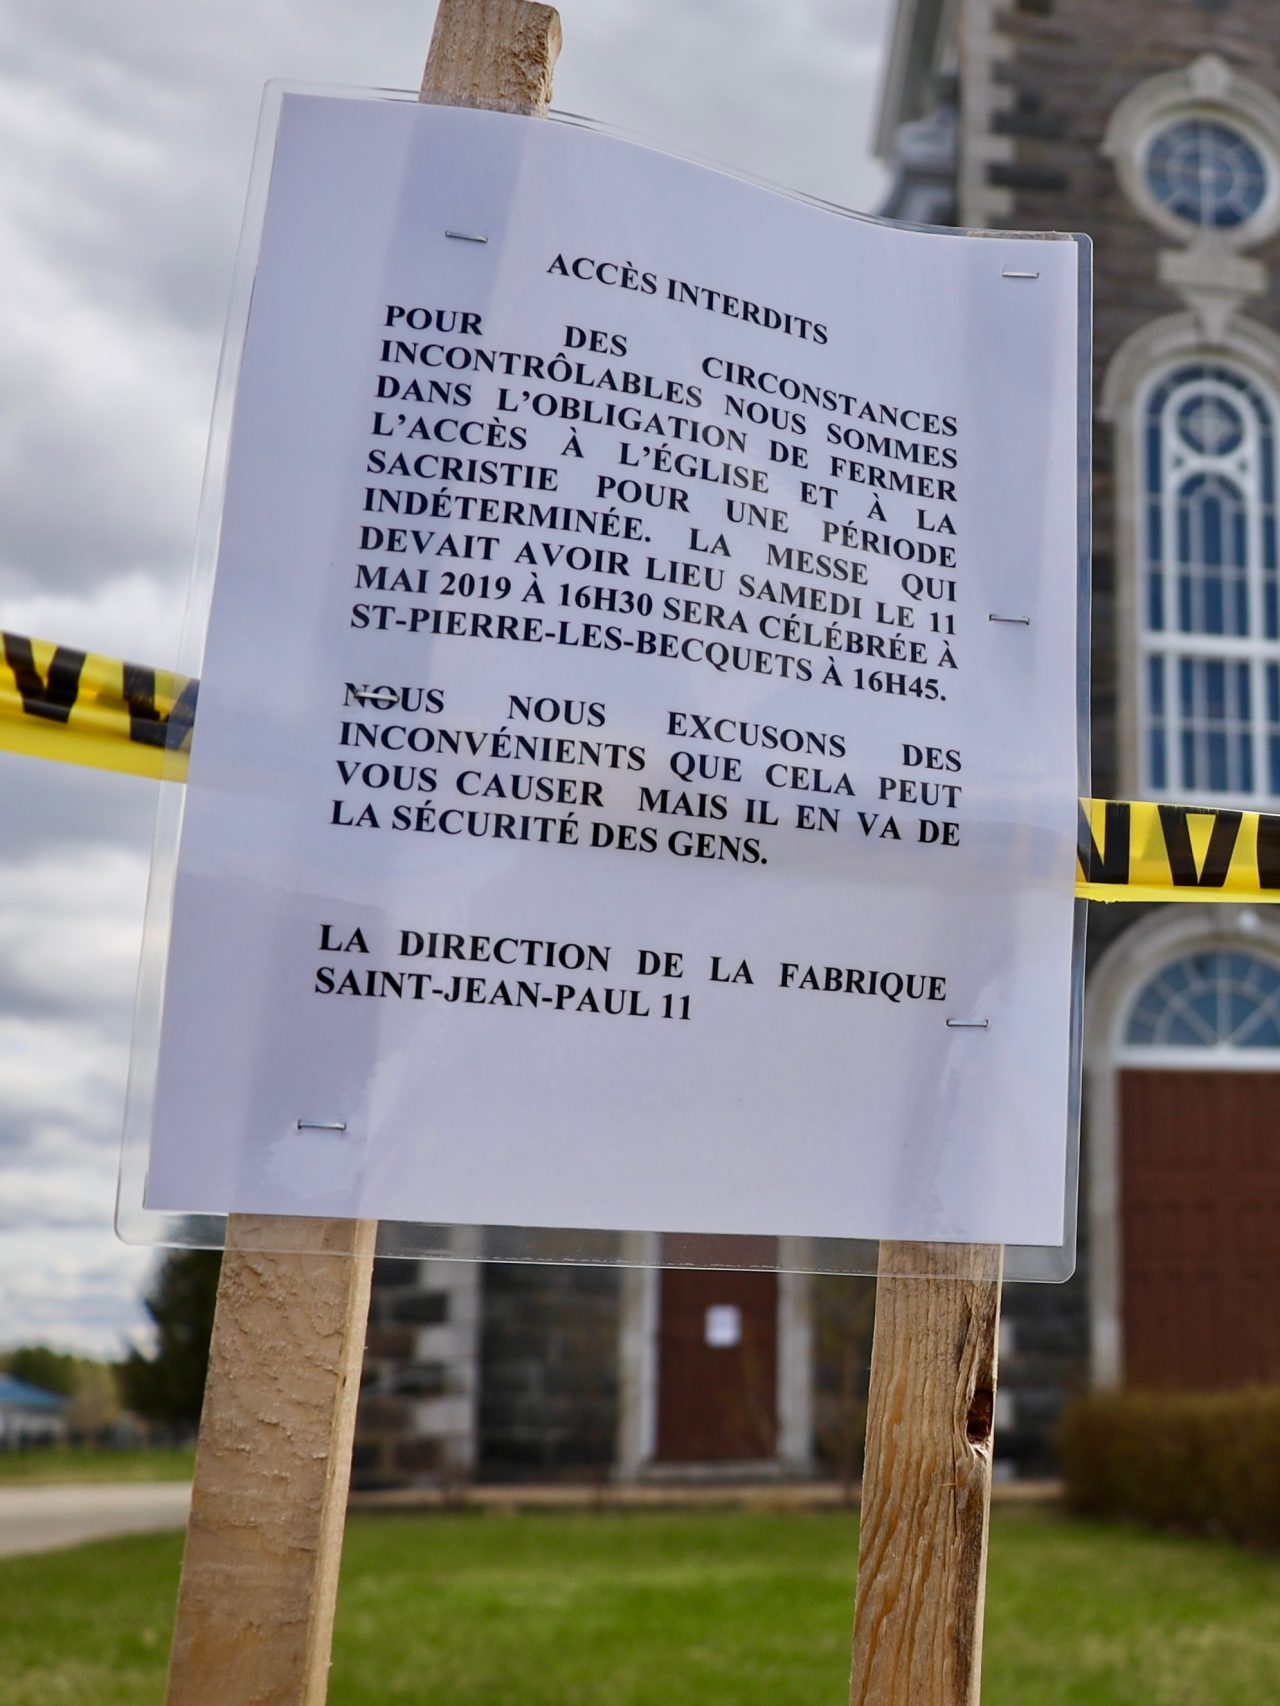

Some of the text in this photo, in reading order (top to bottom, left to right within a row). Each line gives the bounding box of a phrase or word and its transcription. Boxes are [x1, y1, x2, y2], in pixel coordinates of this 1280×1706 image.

[546, 253, 828, 345] ACCÈS INTERDITS
[380, 339, 958, 469] INCONTRÔLABLES NOUS SOMMES
[384, 304, 958, 437] POUR DES CIRCONSTANCES
[376, 374, 472, 407] DANS
[769, 439, 809, 470] DE
[829, 455, 958, 502] FERMER
[560, 426, 585, 459] À
[800, 480, 839, 510] ET
[866, 492, 888, 523] À
[917, 508, 957, 536] LA
[363, 486, 957, 603] INDÉTERMINÉE. LA MESSE QUI
[366, 449, 957, 569] SACRISTIE POUR UNE PÉRIODE
[355, 564, 959, 670] MAI 2019 À 16H30 SERA CÉLÉBRÉE À
[359, 525, 956, 636] DEVAIT AVOIR LIEU SAMEDI LE 11
[350, 603, 947, 702] ST-PIERRE-LES-BECQUETS À 16H45.
[339, 721, 962, 809] INCONVÉNIENTS QUE CELA PEUT
[342, 682, 962, 773] NOUS NOUS EXCUSONS DES
[330, 799, 768, 865] LA SÉCURITÉ DES GENS.
[335, 759, 961, 847] VOUS CAUSER MAIS IL EN VA DE
[314, 966, 691, 1021] SAINT-JEAN-PAUL 11
[319, 923, 947, 1004] LA DIRECTION DE LA FABRIQUE
